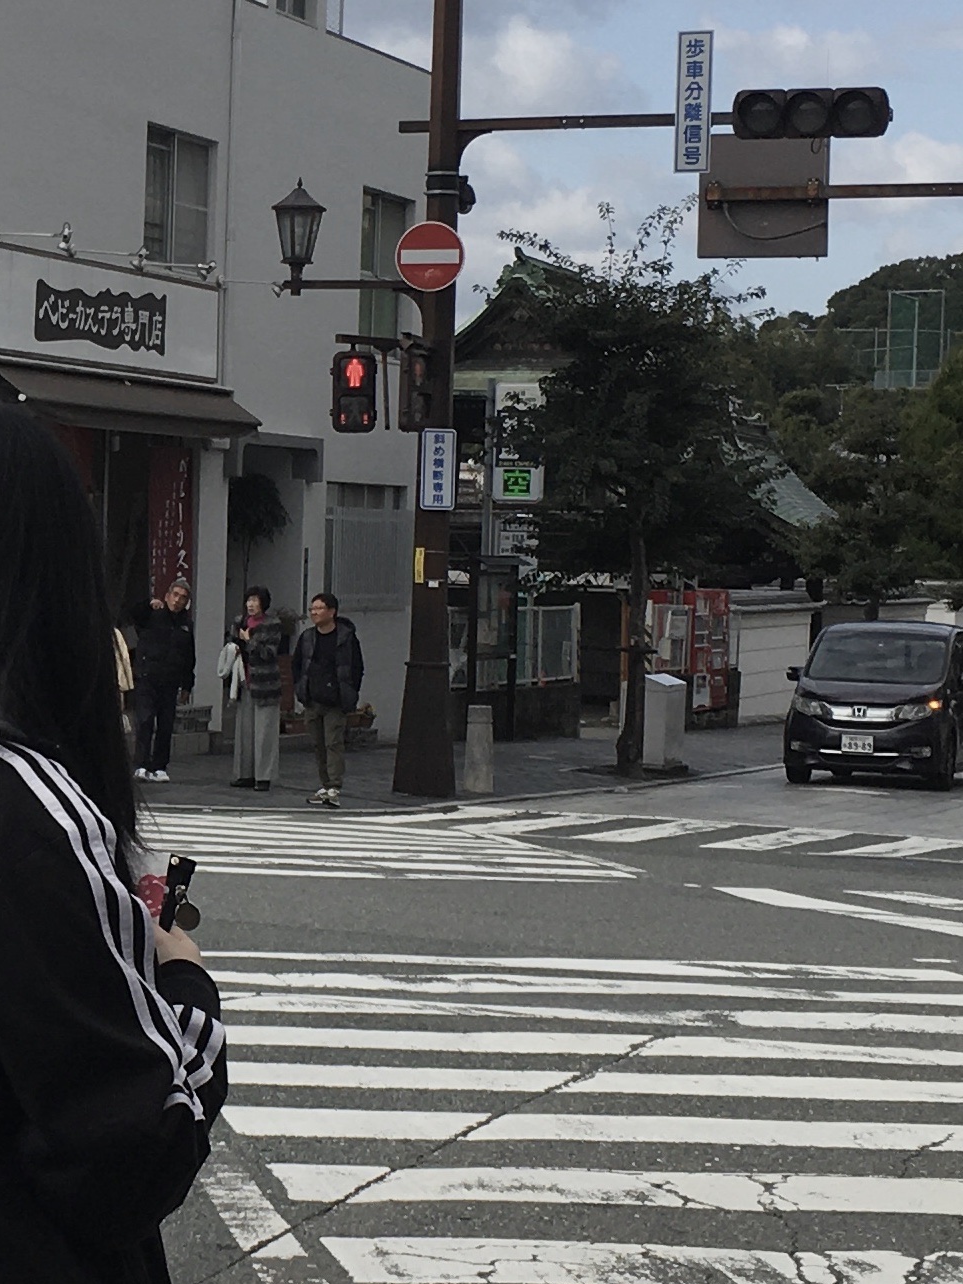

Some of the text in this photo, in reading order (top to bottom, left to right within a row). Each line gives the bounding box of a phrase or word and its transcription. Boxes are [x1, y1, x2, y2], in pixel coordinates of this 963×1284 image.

[683, 38, 705, 165] 歩車分離信号
[38, 293, 163, 347] ベビーカステラ専門店
[432, 433, 446, 505] 斜め横断専用
[503, 469, 530, 497] 空
